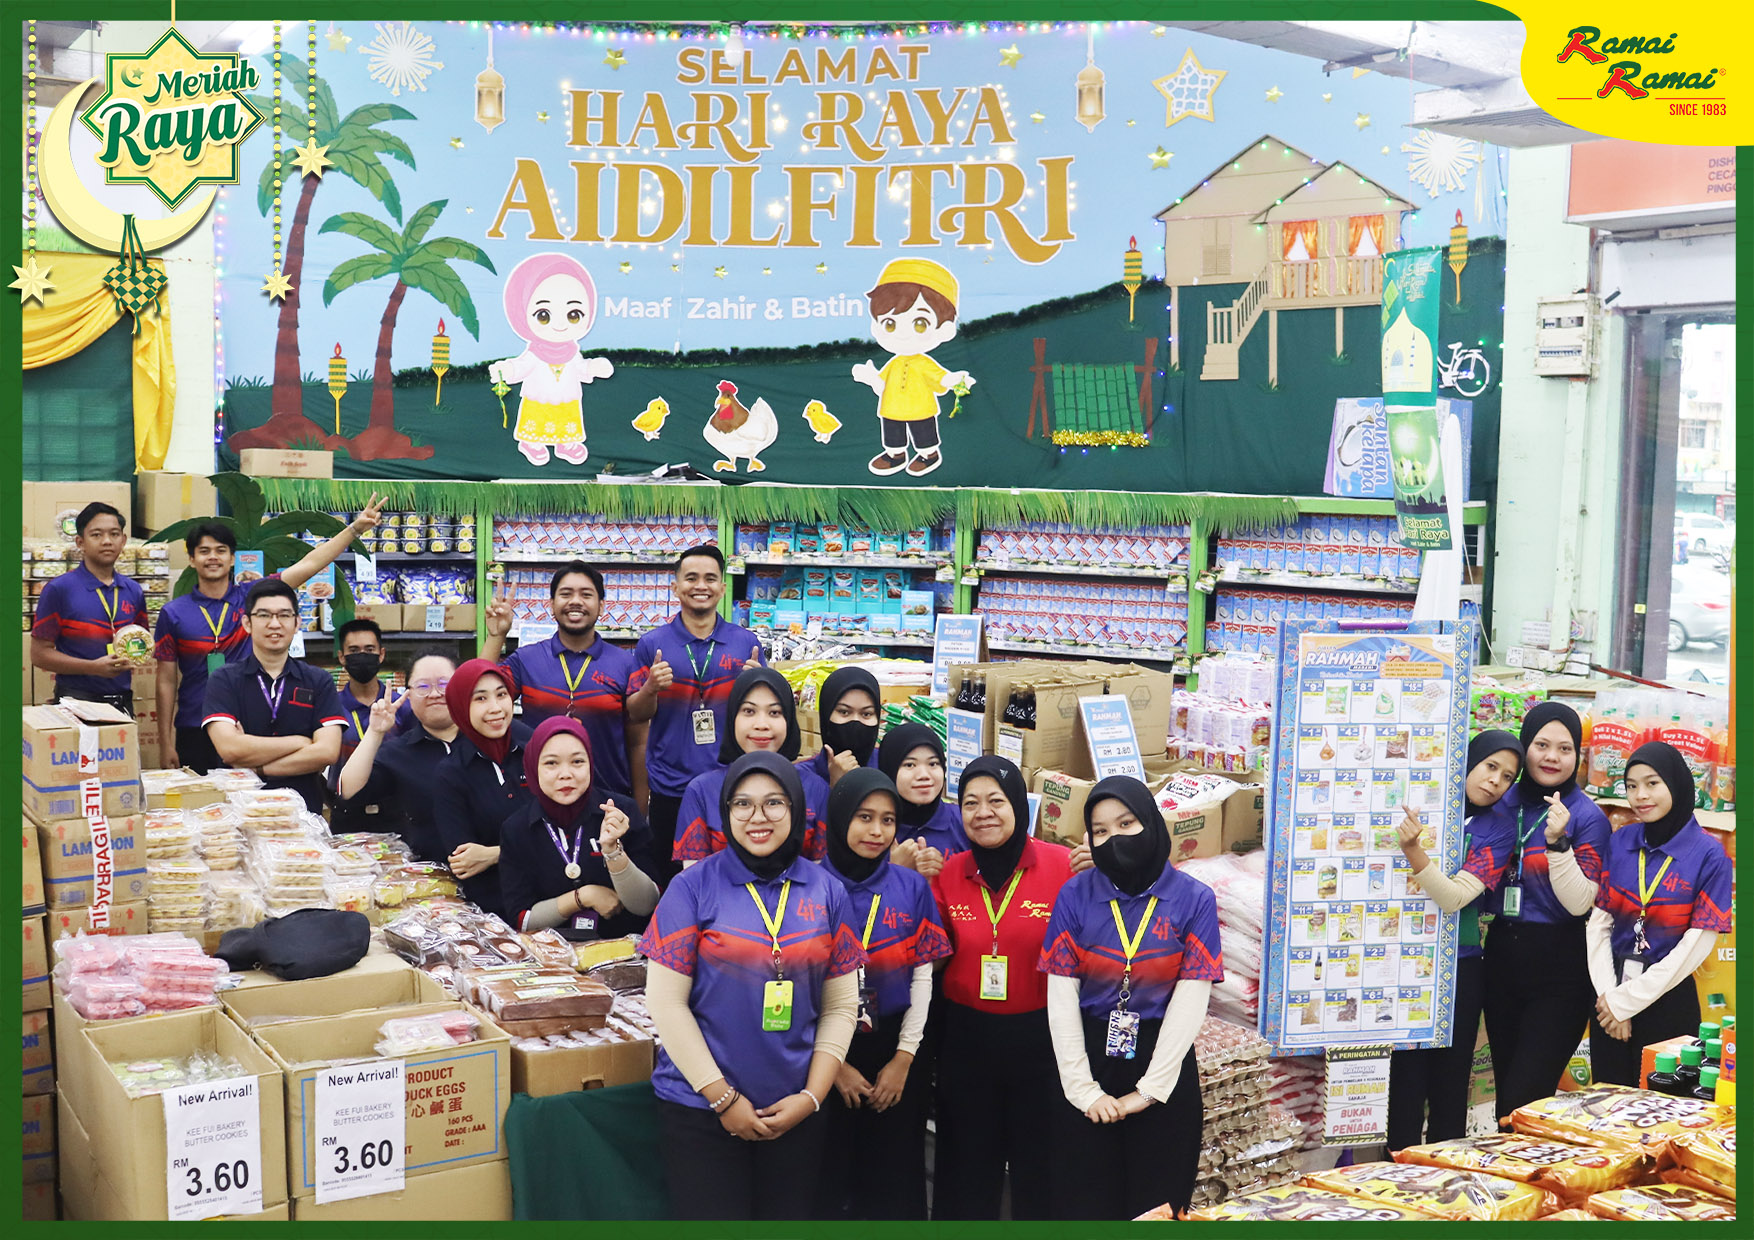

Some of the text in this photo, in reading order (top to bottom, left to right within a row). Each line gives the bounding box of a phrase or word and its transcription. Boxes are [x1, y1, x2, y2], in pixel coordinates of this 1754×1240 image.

[678, 45, 930, 85] SELAMAT
[567, 87, 1016, 162] HARI RAYA
[1708, 156, 1736, 168] DISH
[487, 157, 1075, 264] AIDILFITRI
[605, 294, 863, 320] Maaf Zahir & Batin
[1361, 424, 1375, 493] kelapa
[1420, 528, 1449, 541] Raya
[1305, 651, 1378, 666] RAHMAH
[98, 747, 124, 761] OON
[1045, 781, 1071, 794] TEPUNG
[86, 782, 99, 816] ILE
[1175, 817, 1205, 830] TEPUNG
[62, 841, 92, 857] LAM
[1339, 1051, 1380, 1059] PERINGATAN
[328, 1067, 398, 1087] New Arrival!
[178, 1084, 252, 1107] New Arrival!
[436, 1081, 466, 1097] EGGS
[1330, 1082, 1386, 1097] ISI RUMAH
[335, 1108, 350, 1116] KEE
[364, 1102, 391, 1113] BAKERY
[1341, 1107, 1372, 1118] BUKAN
[333, 1111, 394, 1127] BUTTER COOKIES
[448, 1115, 473, 1125] 160 PCS
[186, 1127, 200, 1136] KEE
[217, 1120, 246, 1132] BAKERY
[445, 1127, 467, 1137] GRADE
[472, 1124, 486, 1132] AAA
[1332, 1122, 1378, 1135] PENIAGA
[184, 1130, 248, 1147] BUTTER COOKIES
[322, 1137, 337, 1146] RM
[444, 1139, 460, 1148] DATE
[173, 1158, 189, 1169] RM
[334, 1139, 393, 1174] 3.60
[186, 1160, 249, 1197] 3.60
